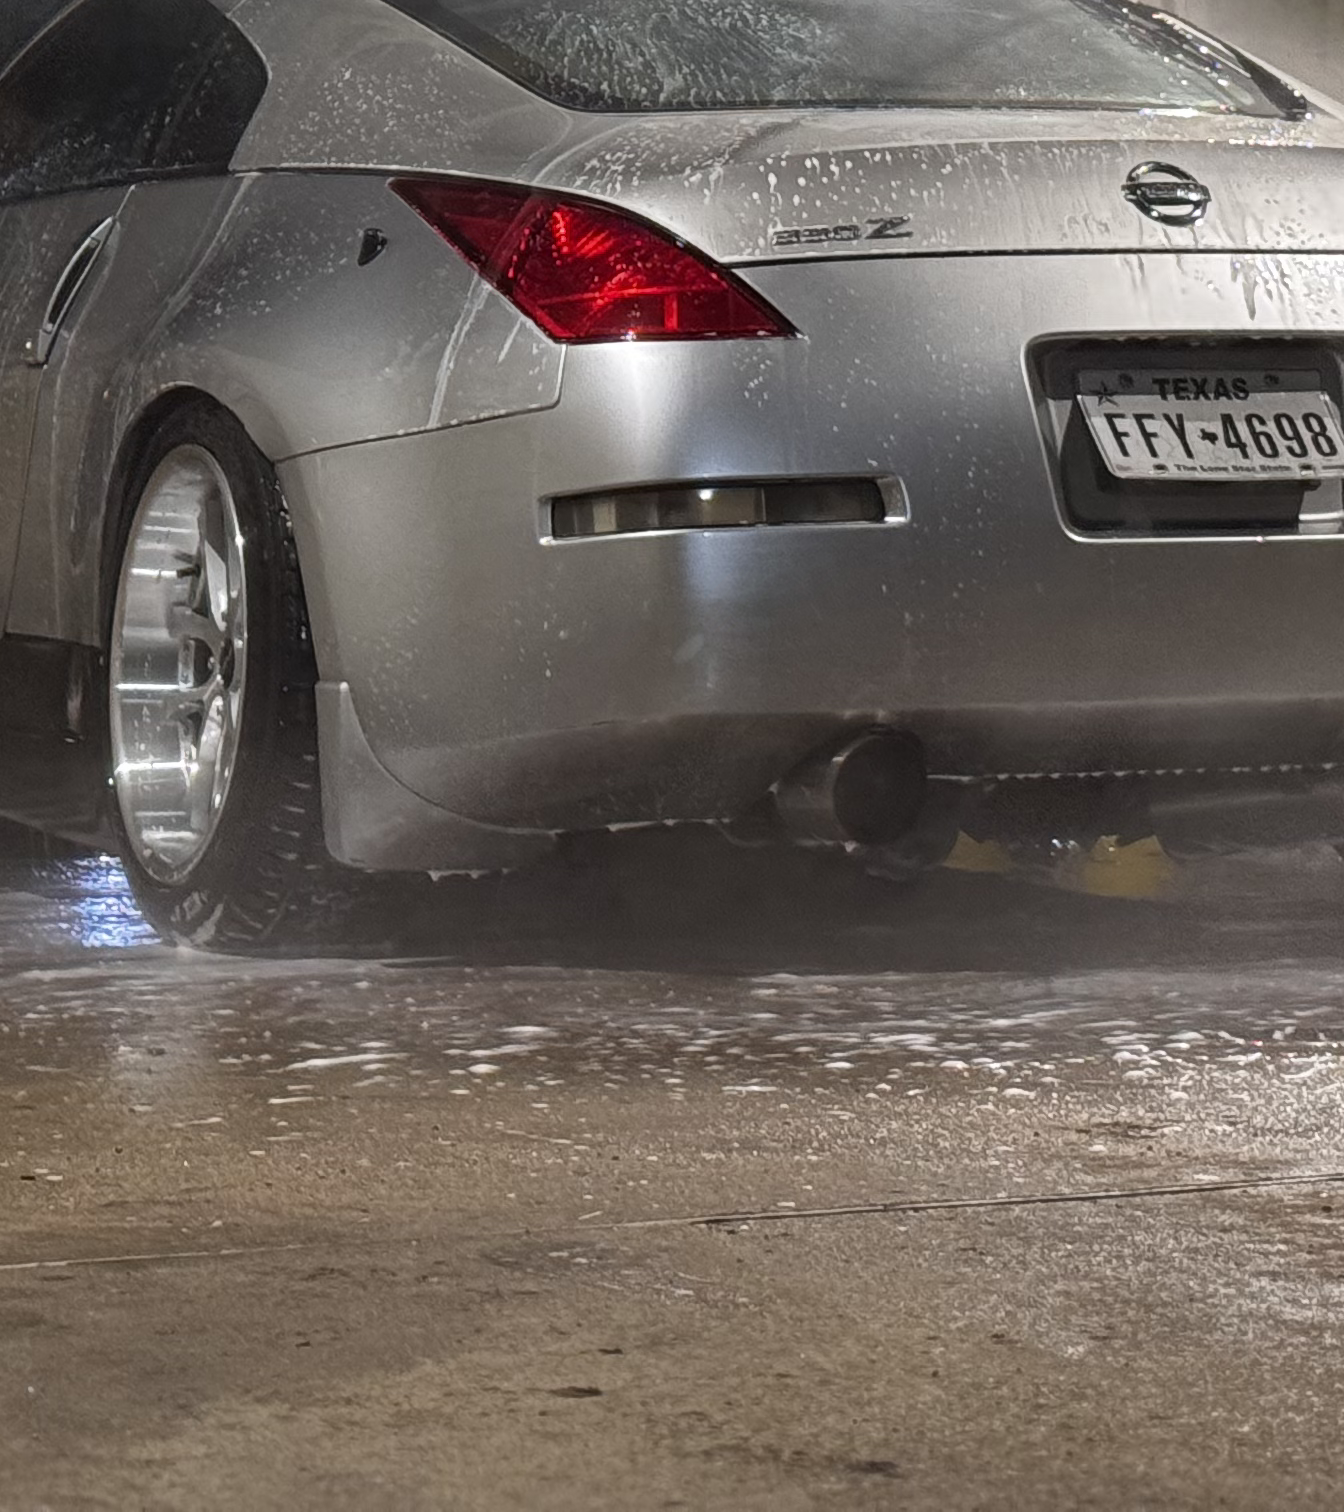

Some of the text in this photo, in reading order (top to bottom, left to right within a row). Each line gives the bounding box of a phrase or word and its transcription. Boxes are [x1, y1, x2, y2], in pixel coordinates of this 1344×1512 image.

[1152, 377, 1251, 402] TEXAS
[1104, 411, 1339, 461] FFY 4698
